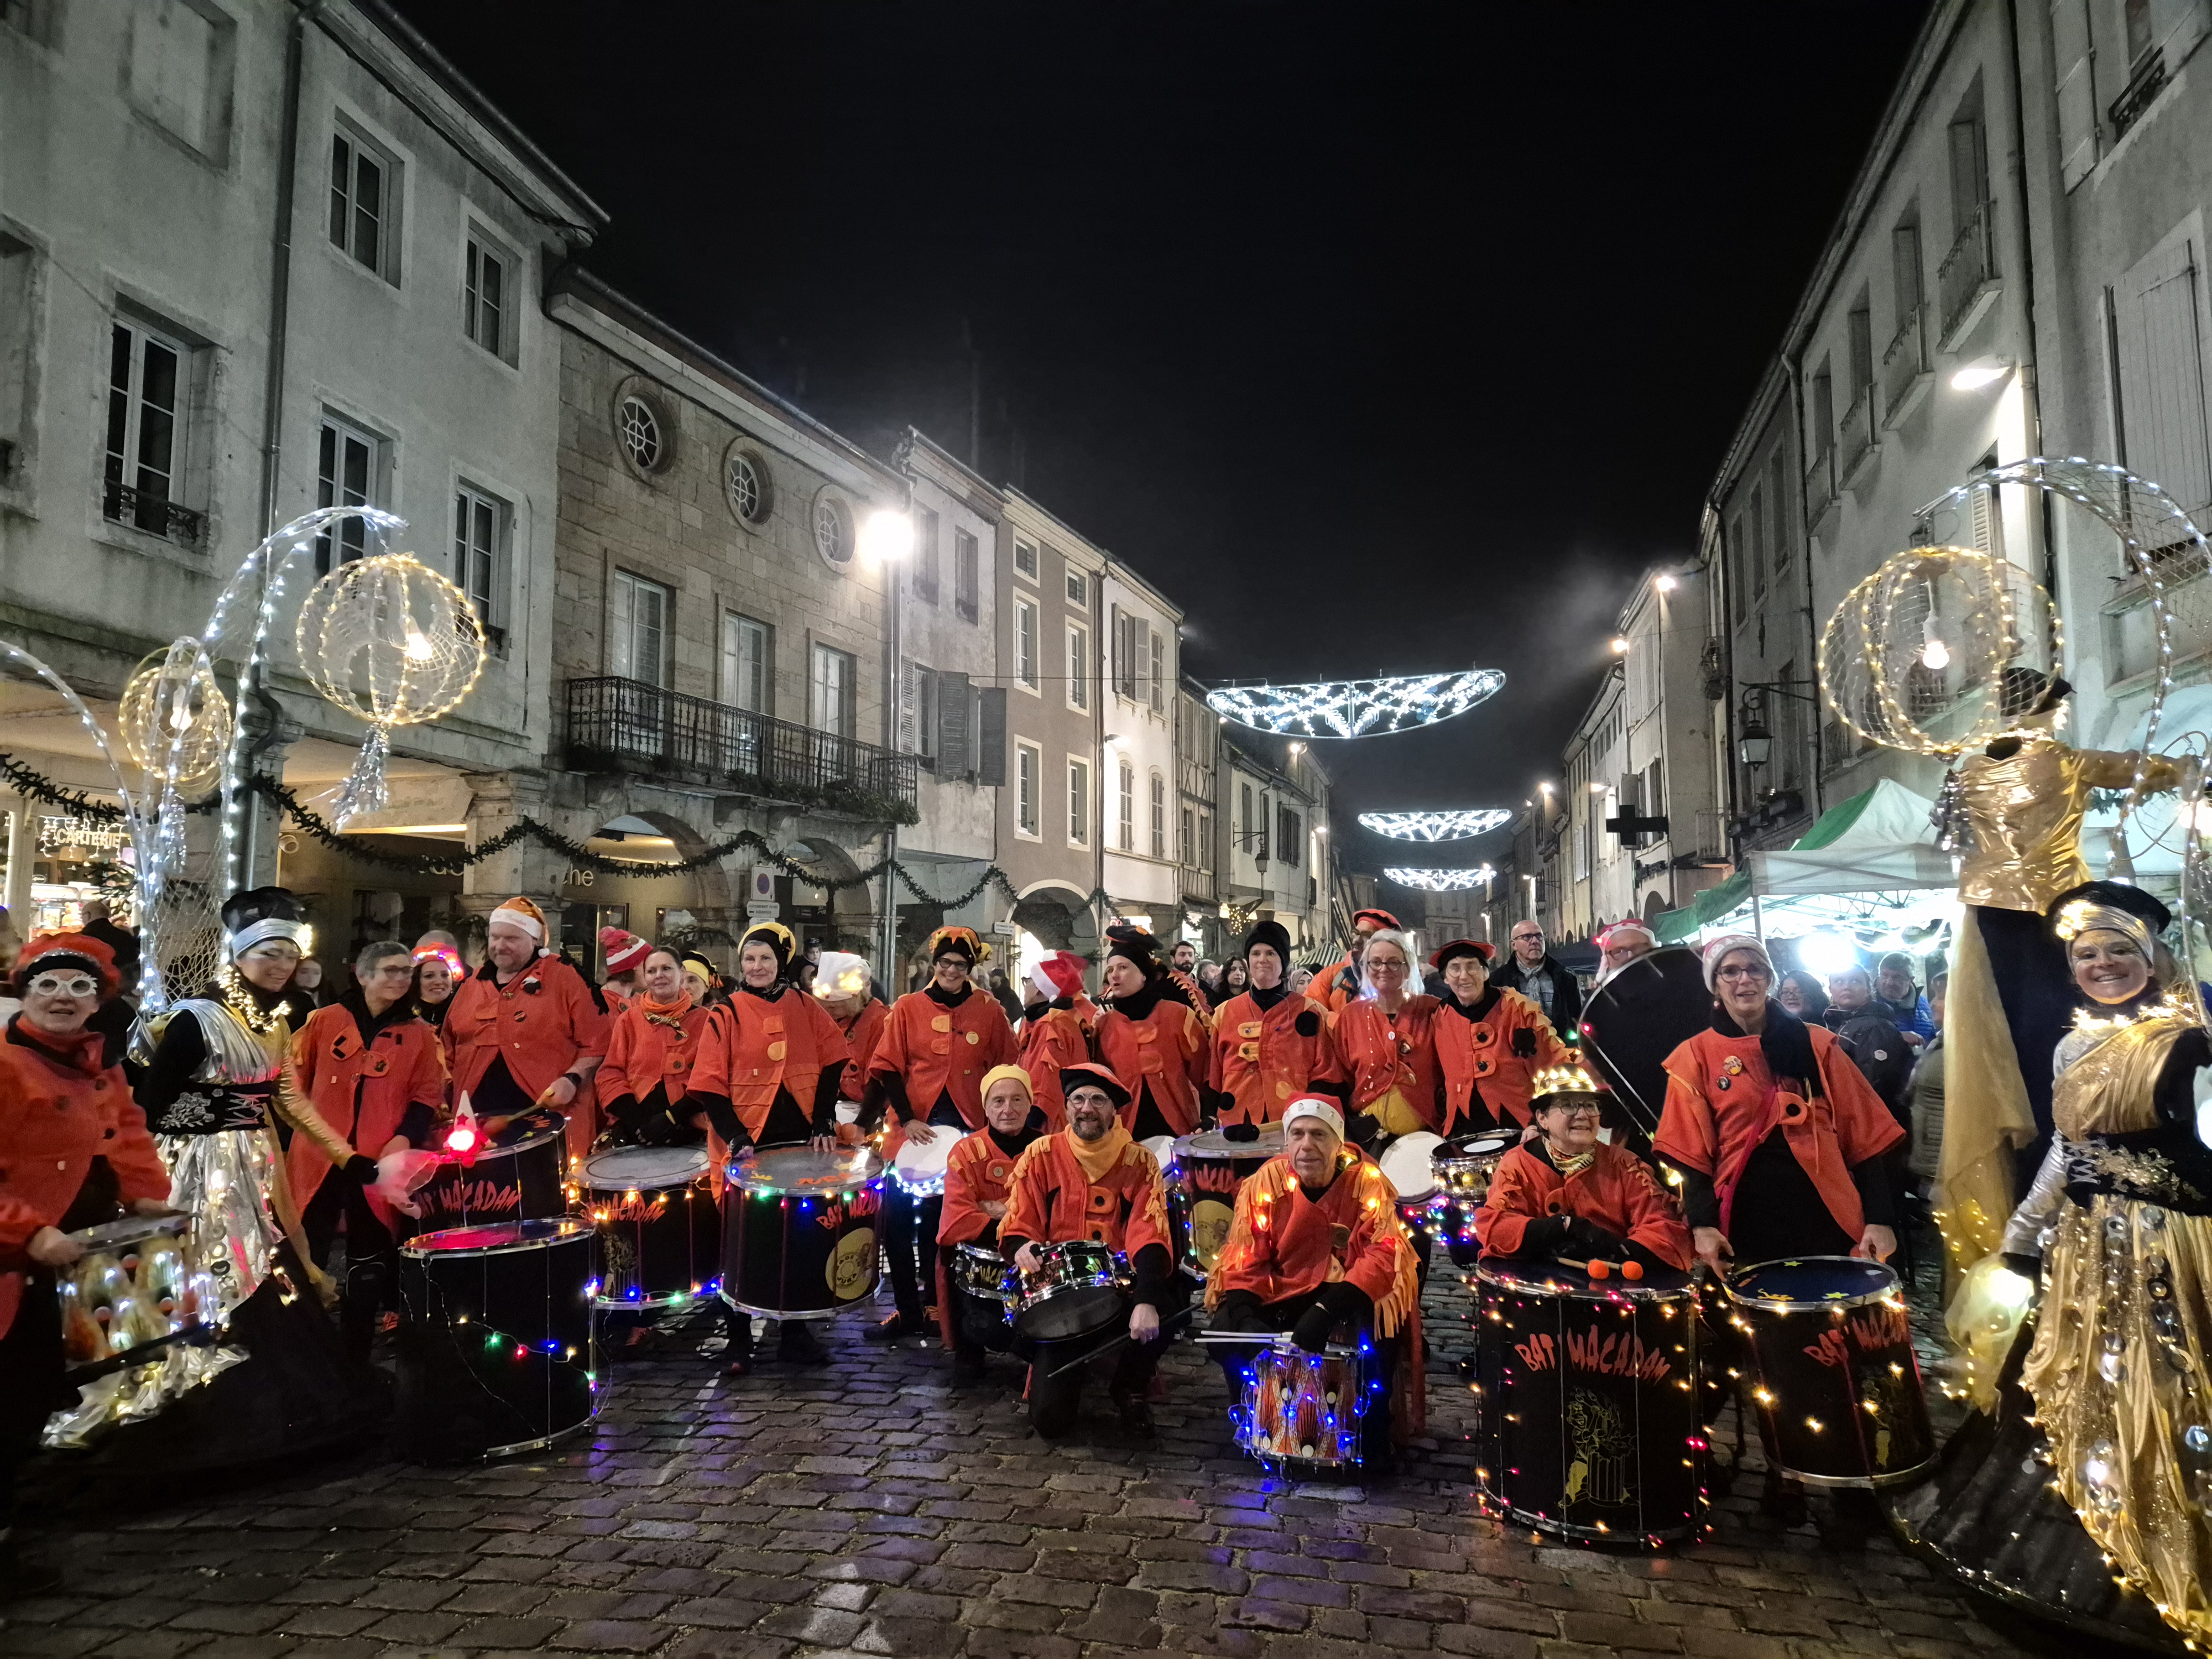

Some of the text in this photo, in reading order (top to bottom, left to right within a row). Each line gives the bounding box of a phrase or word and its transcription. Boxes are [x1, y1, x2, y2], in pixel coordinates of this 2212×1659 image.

[56, 828, 120, 847] CARTERIE
[563, 863, 593, 886] he
[439, 1179, 523, 1213] MACADAM
[837, 1273, 857, 1284] JURA
[1567, 1324, 1671, 1386] MACADAM
